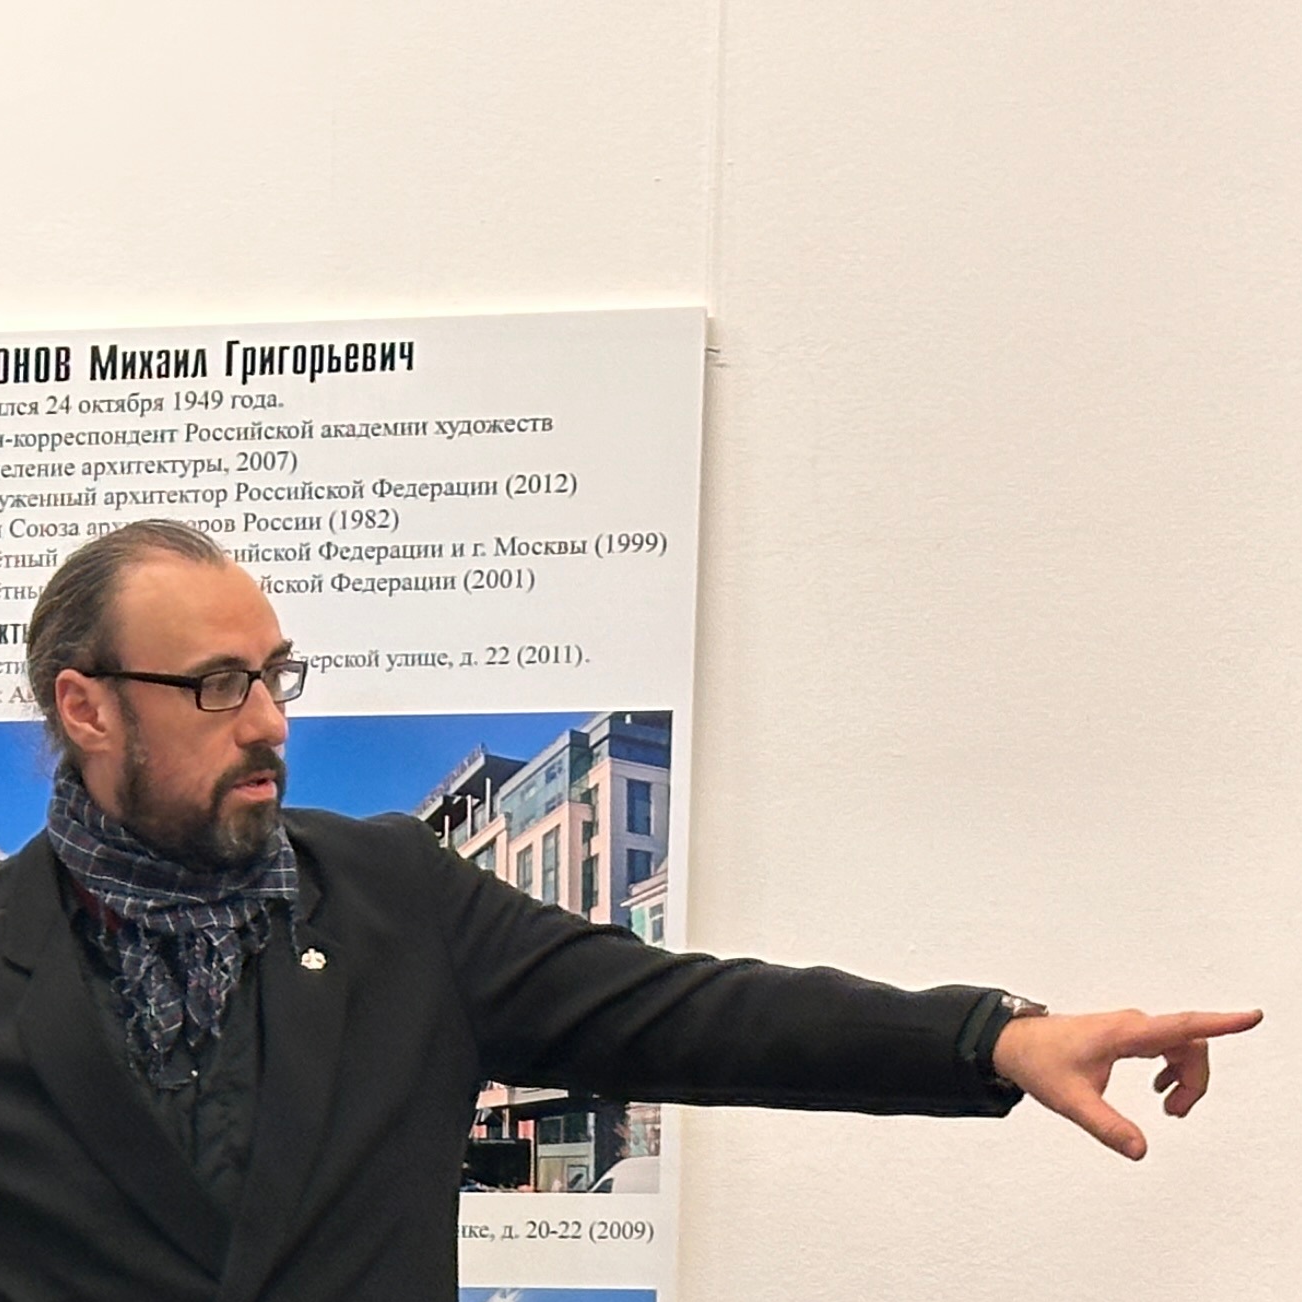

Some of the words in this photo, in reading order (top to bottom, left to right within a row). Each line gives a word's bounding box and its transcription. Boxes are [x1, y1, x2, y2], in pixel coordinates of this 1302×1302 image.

[89, 344, 208, 382] Михаил
[225, 339, 414, 387] Григорьевич
[45, 394, 72, 416] 24
[77, 391, 165, 419] октября
[174, 388, 224, 412] 1949
[230, 393, 285, 411] года.
[184, 419, 314, 444] Российской
[320, 420, 429, 440] академии
[434, 416, 554, 441] художеств
[81, 456, 230, 483] архитектуры,
[235, 449, 298, 475] 2007)
[103, 487, 229, 512] архитектор
[234, 479, 365, 503] Российской
[371, 477, 498, 503] Федерации
[505, 472, 578, 501] (2012)
[8, 517, 78, 539] Союза
[243, 511, 322, 533] России
[328, 507, 400, 535] (1982)
[317, 540, 444, 566] Федерации
[450, 541, 465, 558] и
[471, 542, 487, 558] г.
[493, 535, 588, 557] Москвы
[594, 531, 668, 559] (1999)
[330, 571, 456, 598] Федерации
[463, 567, 536, 594] (2001)
[385, 651, 454, 674] улице,
[458, 651, 479, 668] д.
[485, 645, 510, 667] 22
[516, 644, 591, 670] (2011).
[500, 1225, 520, 1241] д.
[525, 1219, 582, 1240] 20-22
[588, 1219, 655, 1244] (2009)
